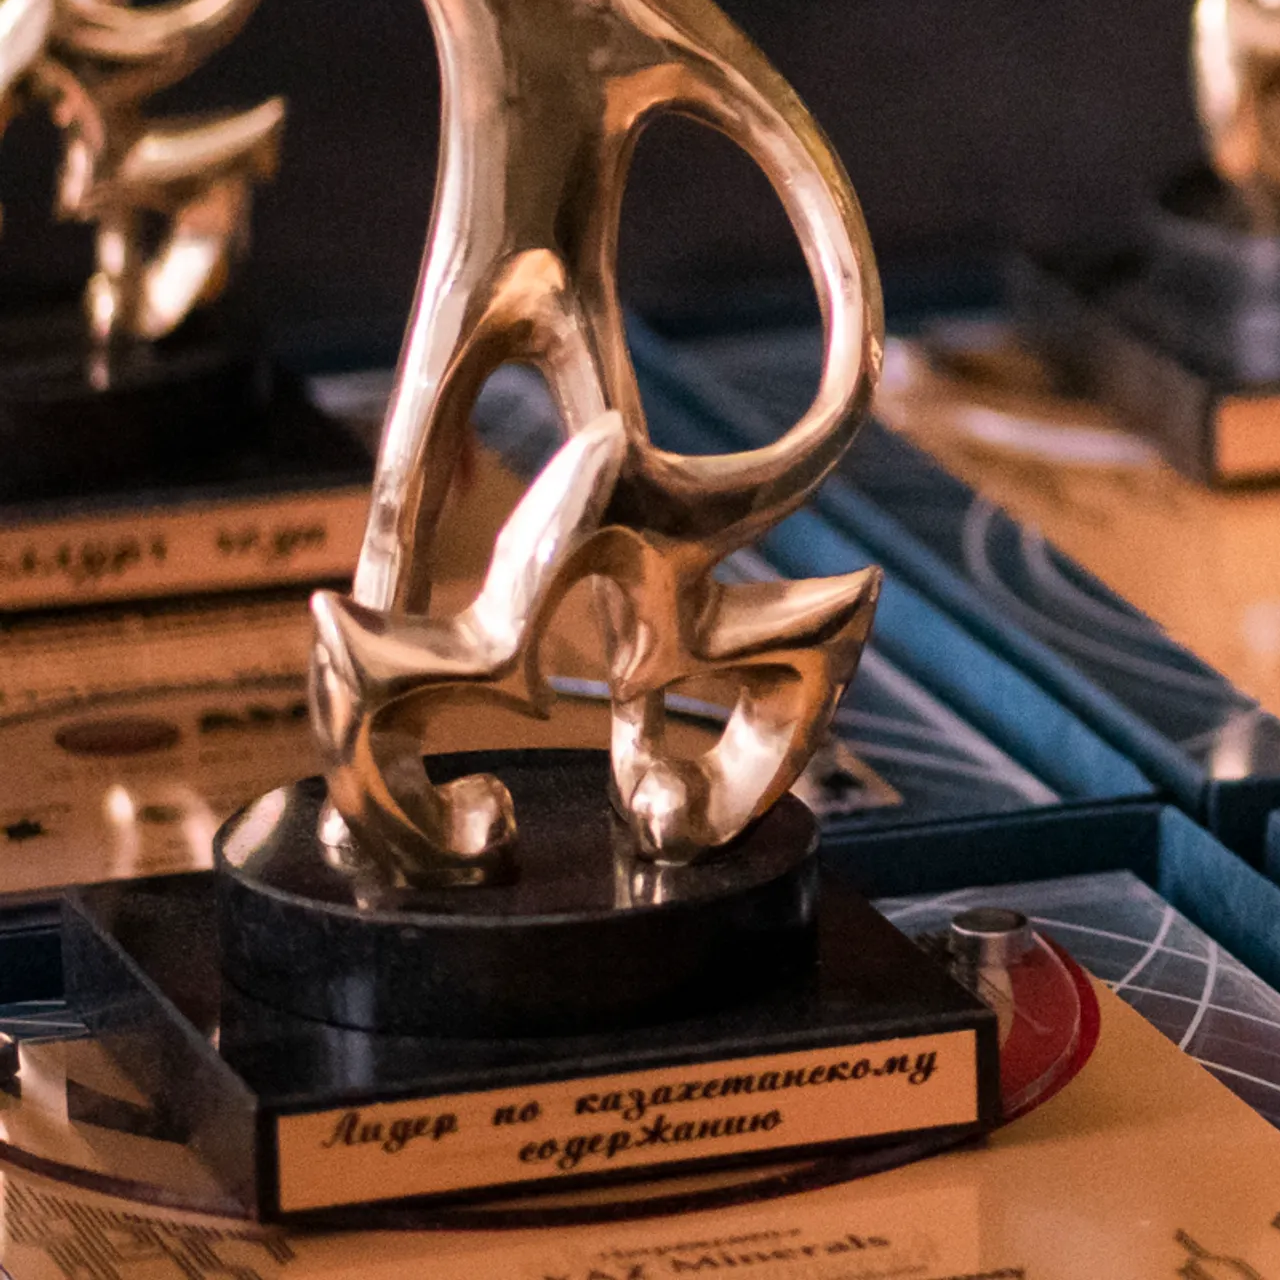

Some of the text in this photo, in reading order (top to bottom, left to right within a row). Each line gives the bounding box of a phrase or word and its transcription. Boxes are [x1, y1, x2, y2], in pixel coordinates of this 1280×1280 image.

[321, 1050, 938, 1154] Лидер по казахстанскому
[518, 1108, 783, 1170] содержанию
